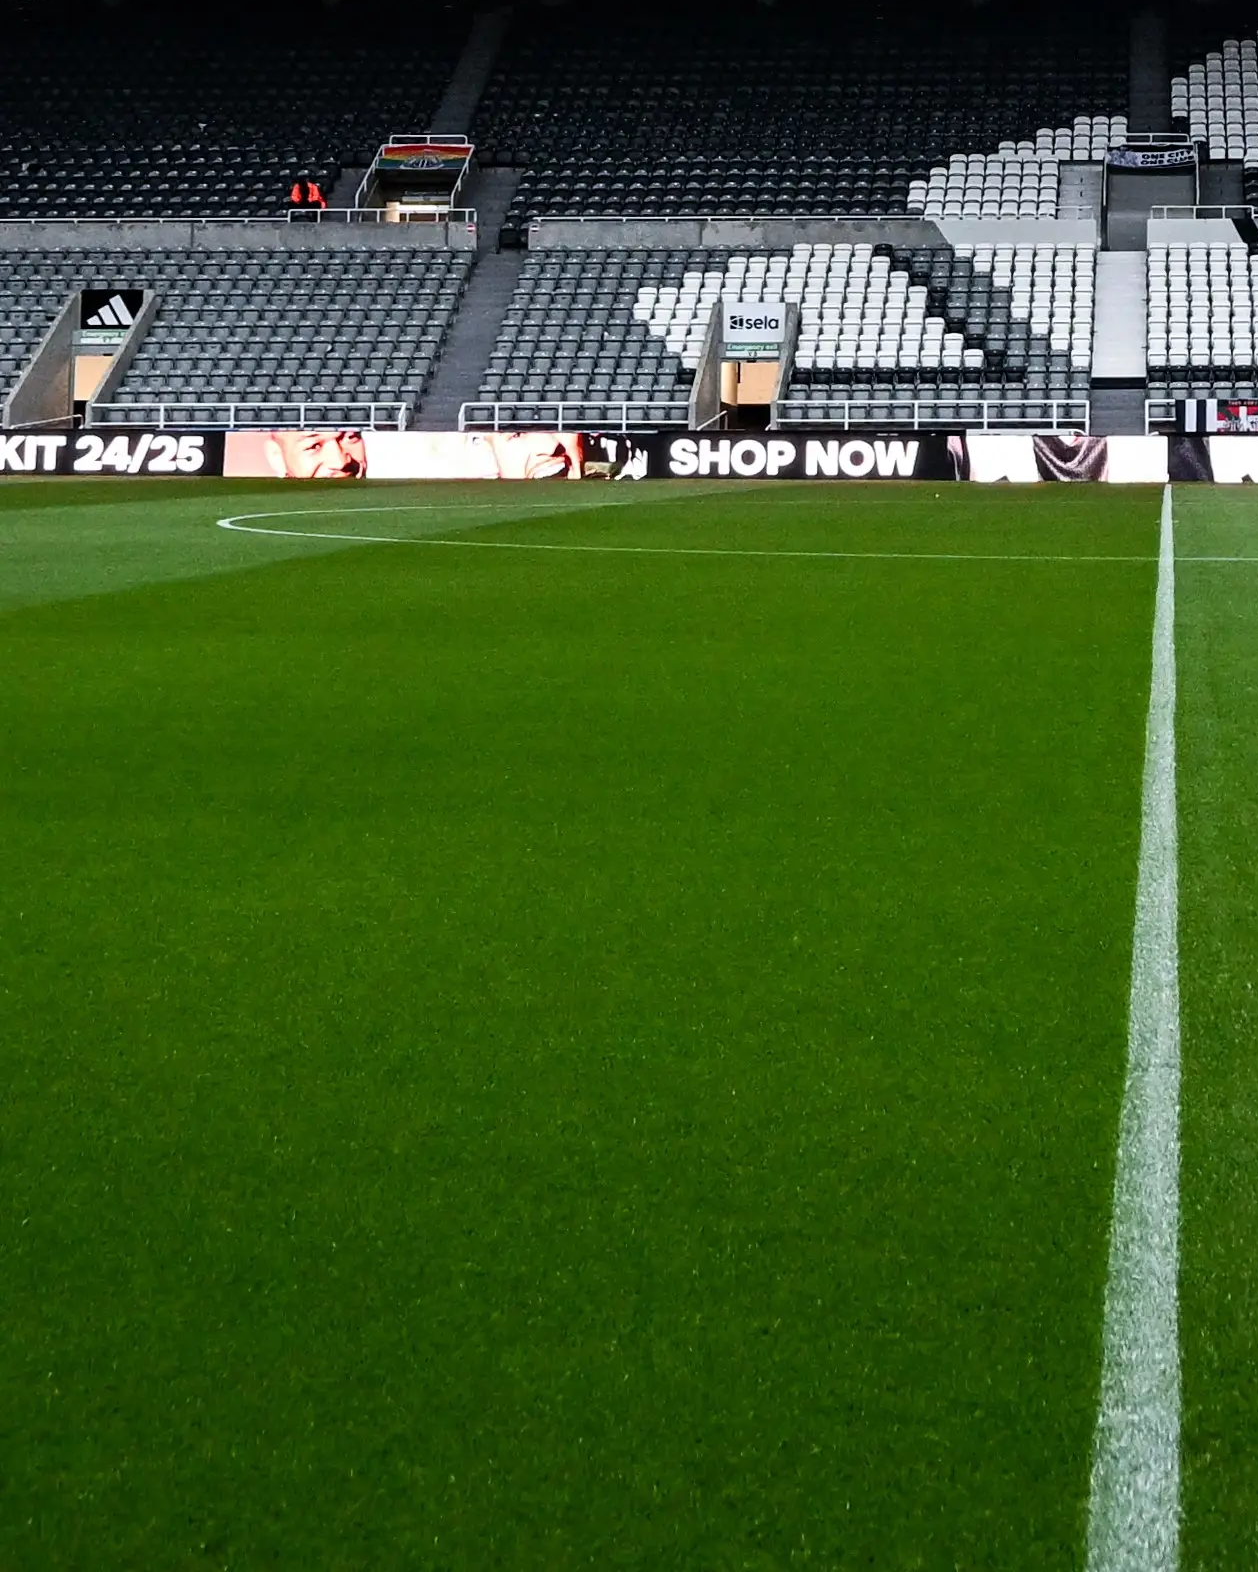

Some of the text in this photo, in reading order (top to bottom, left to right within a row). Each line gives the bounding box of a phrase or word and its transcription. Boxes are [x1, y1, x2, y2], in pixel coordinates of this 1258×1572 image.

[745, 315, 779, 330] sela
[0, 434, 205, 473] KIT 24/25
[669, 438, 919, 477] SHOP NOW
